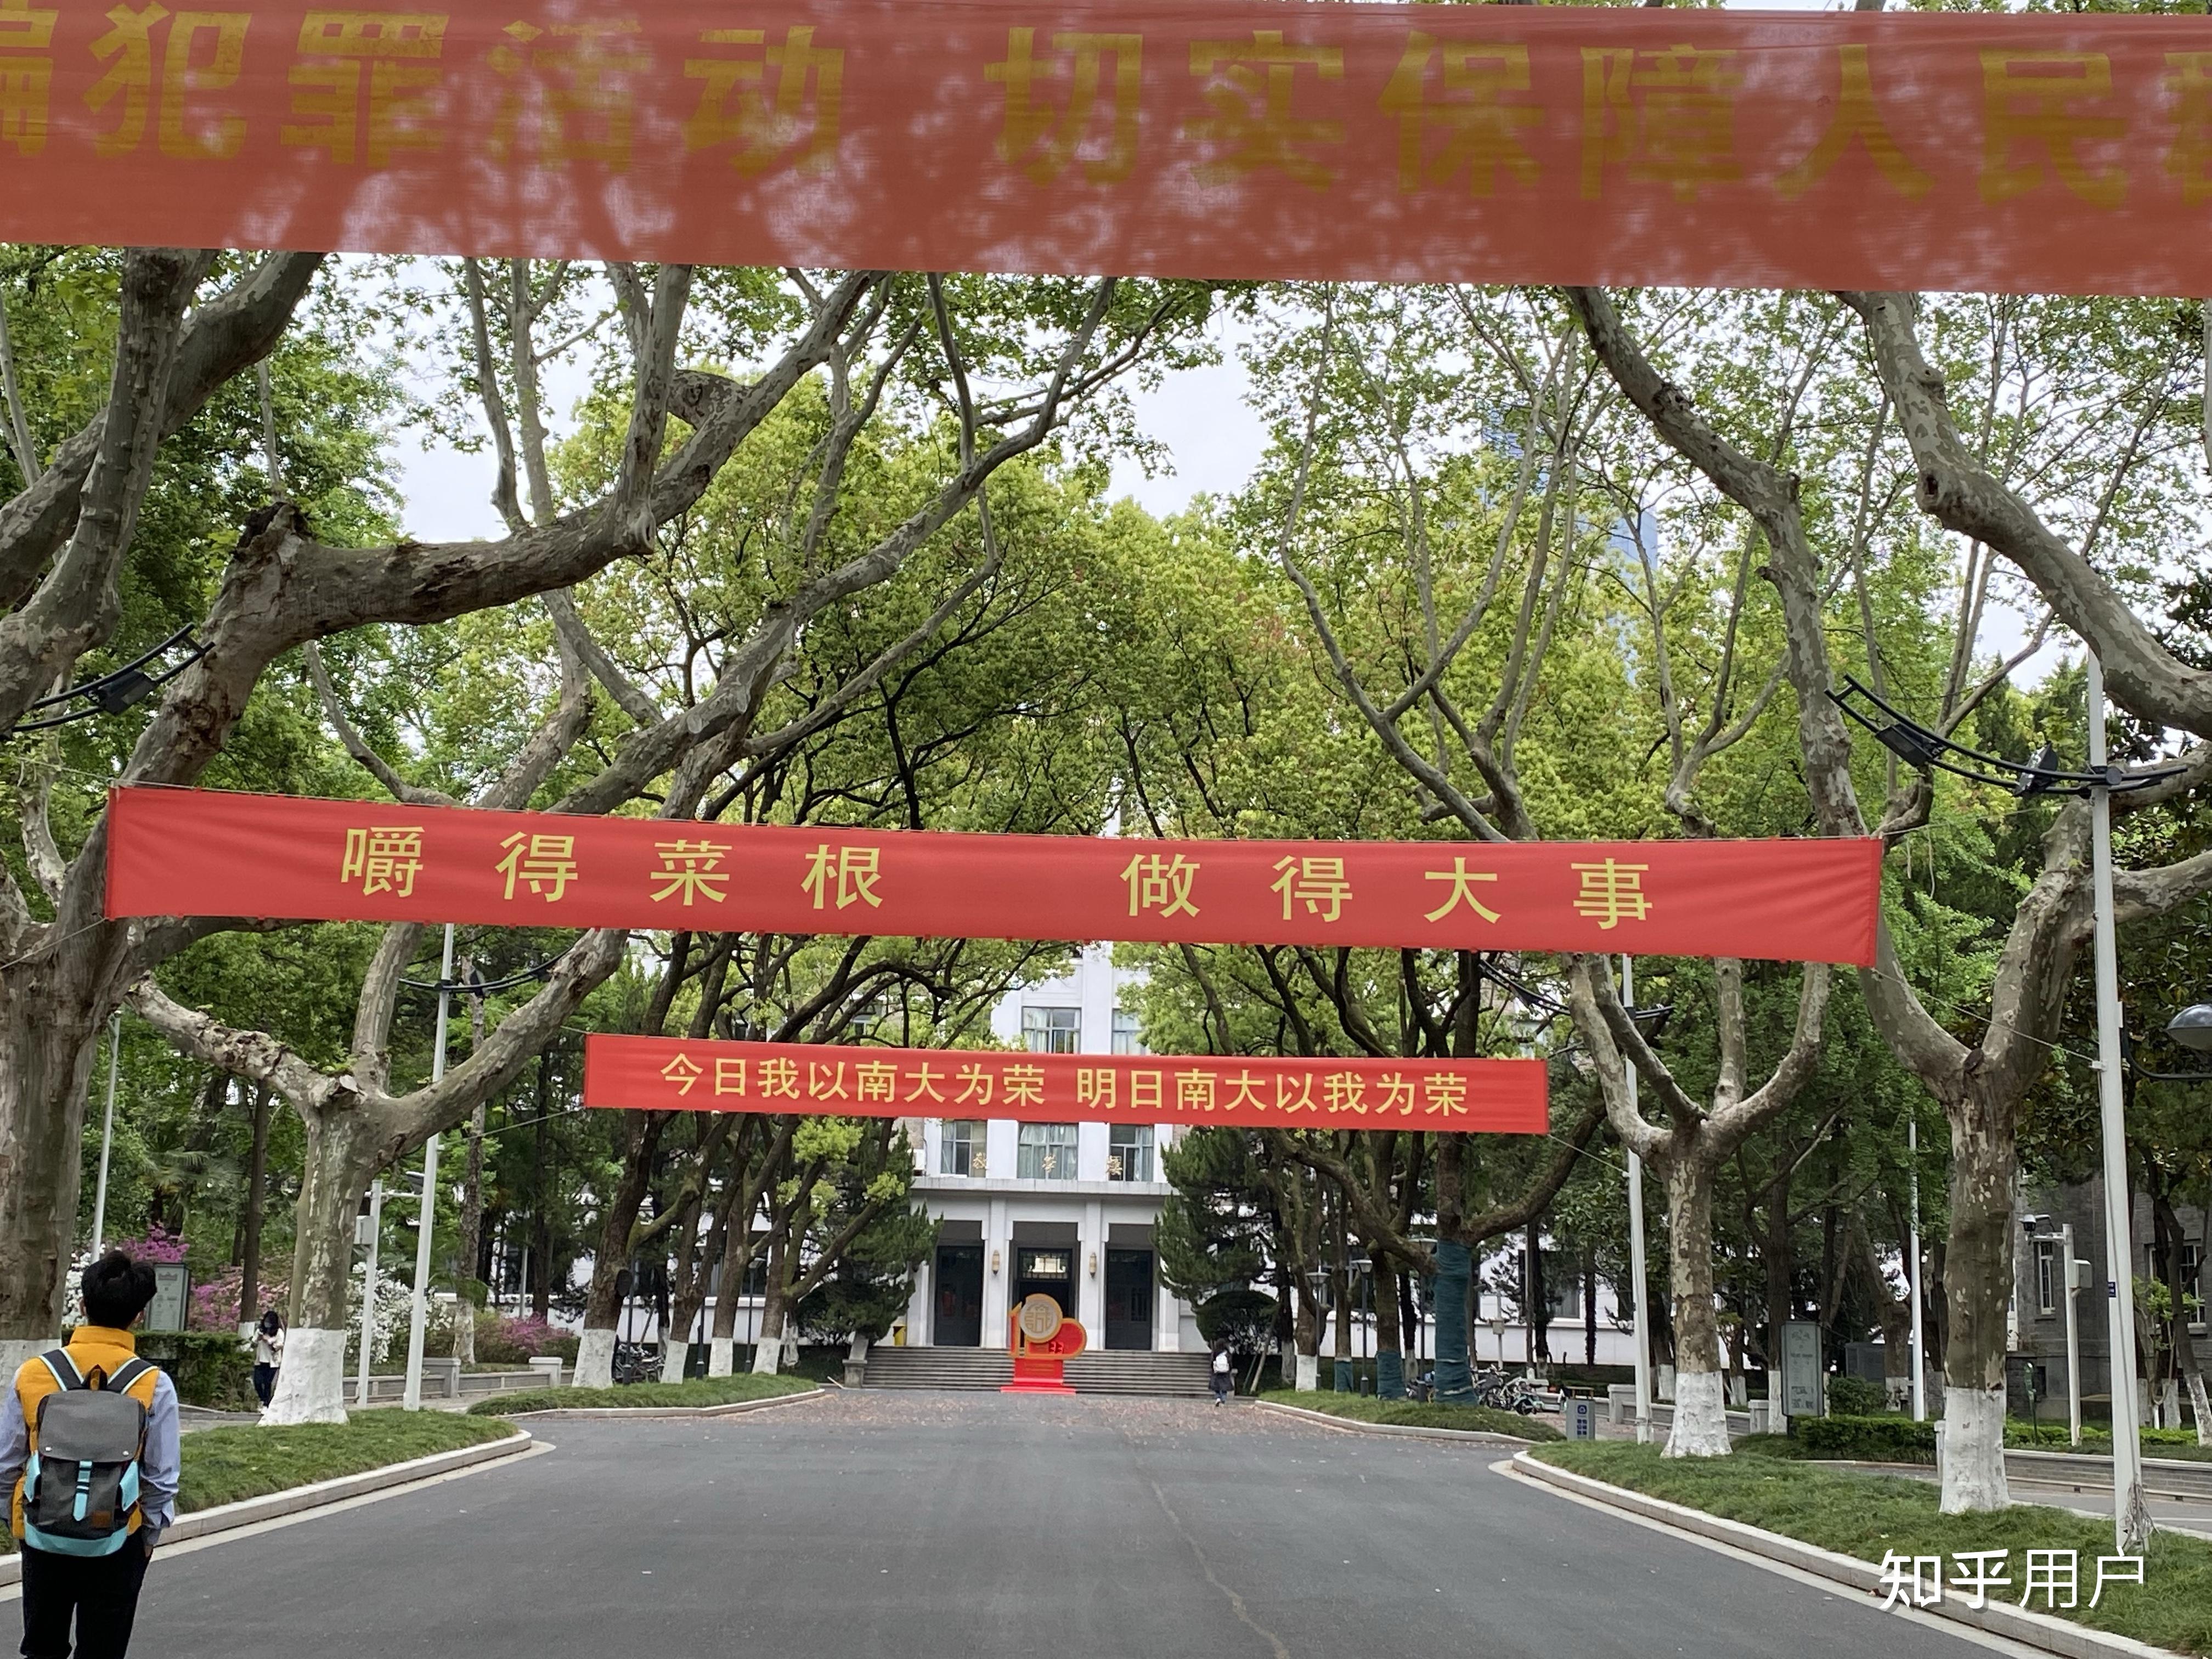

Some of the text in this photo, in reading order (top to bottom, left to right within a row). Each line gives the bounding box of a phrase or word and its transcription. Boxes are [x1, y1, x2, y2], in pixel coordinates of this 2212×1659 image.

[340, 826, 1654, 930] 嚼得菜根 做得大事
[660, 1052, 1469, 1116] 今日我以南大为荣 明日南大以我为荣
